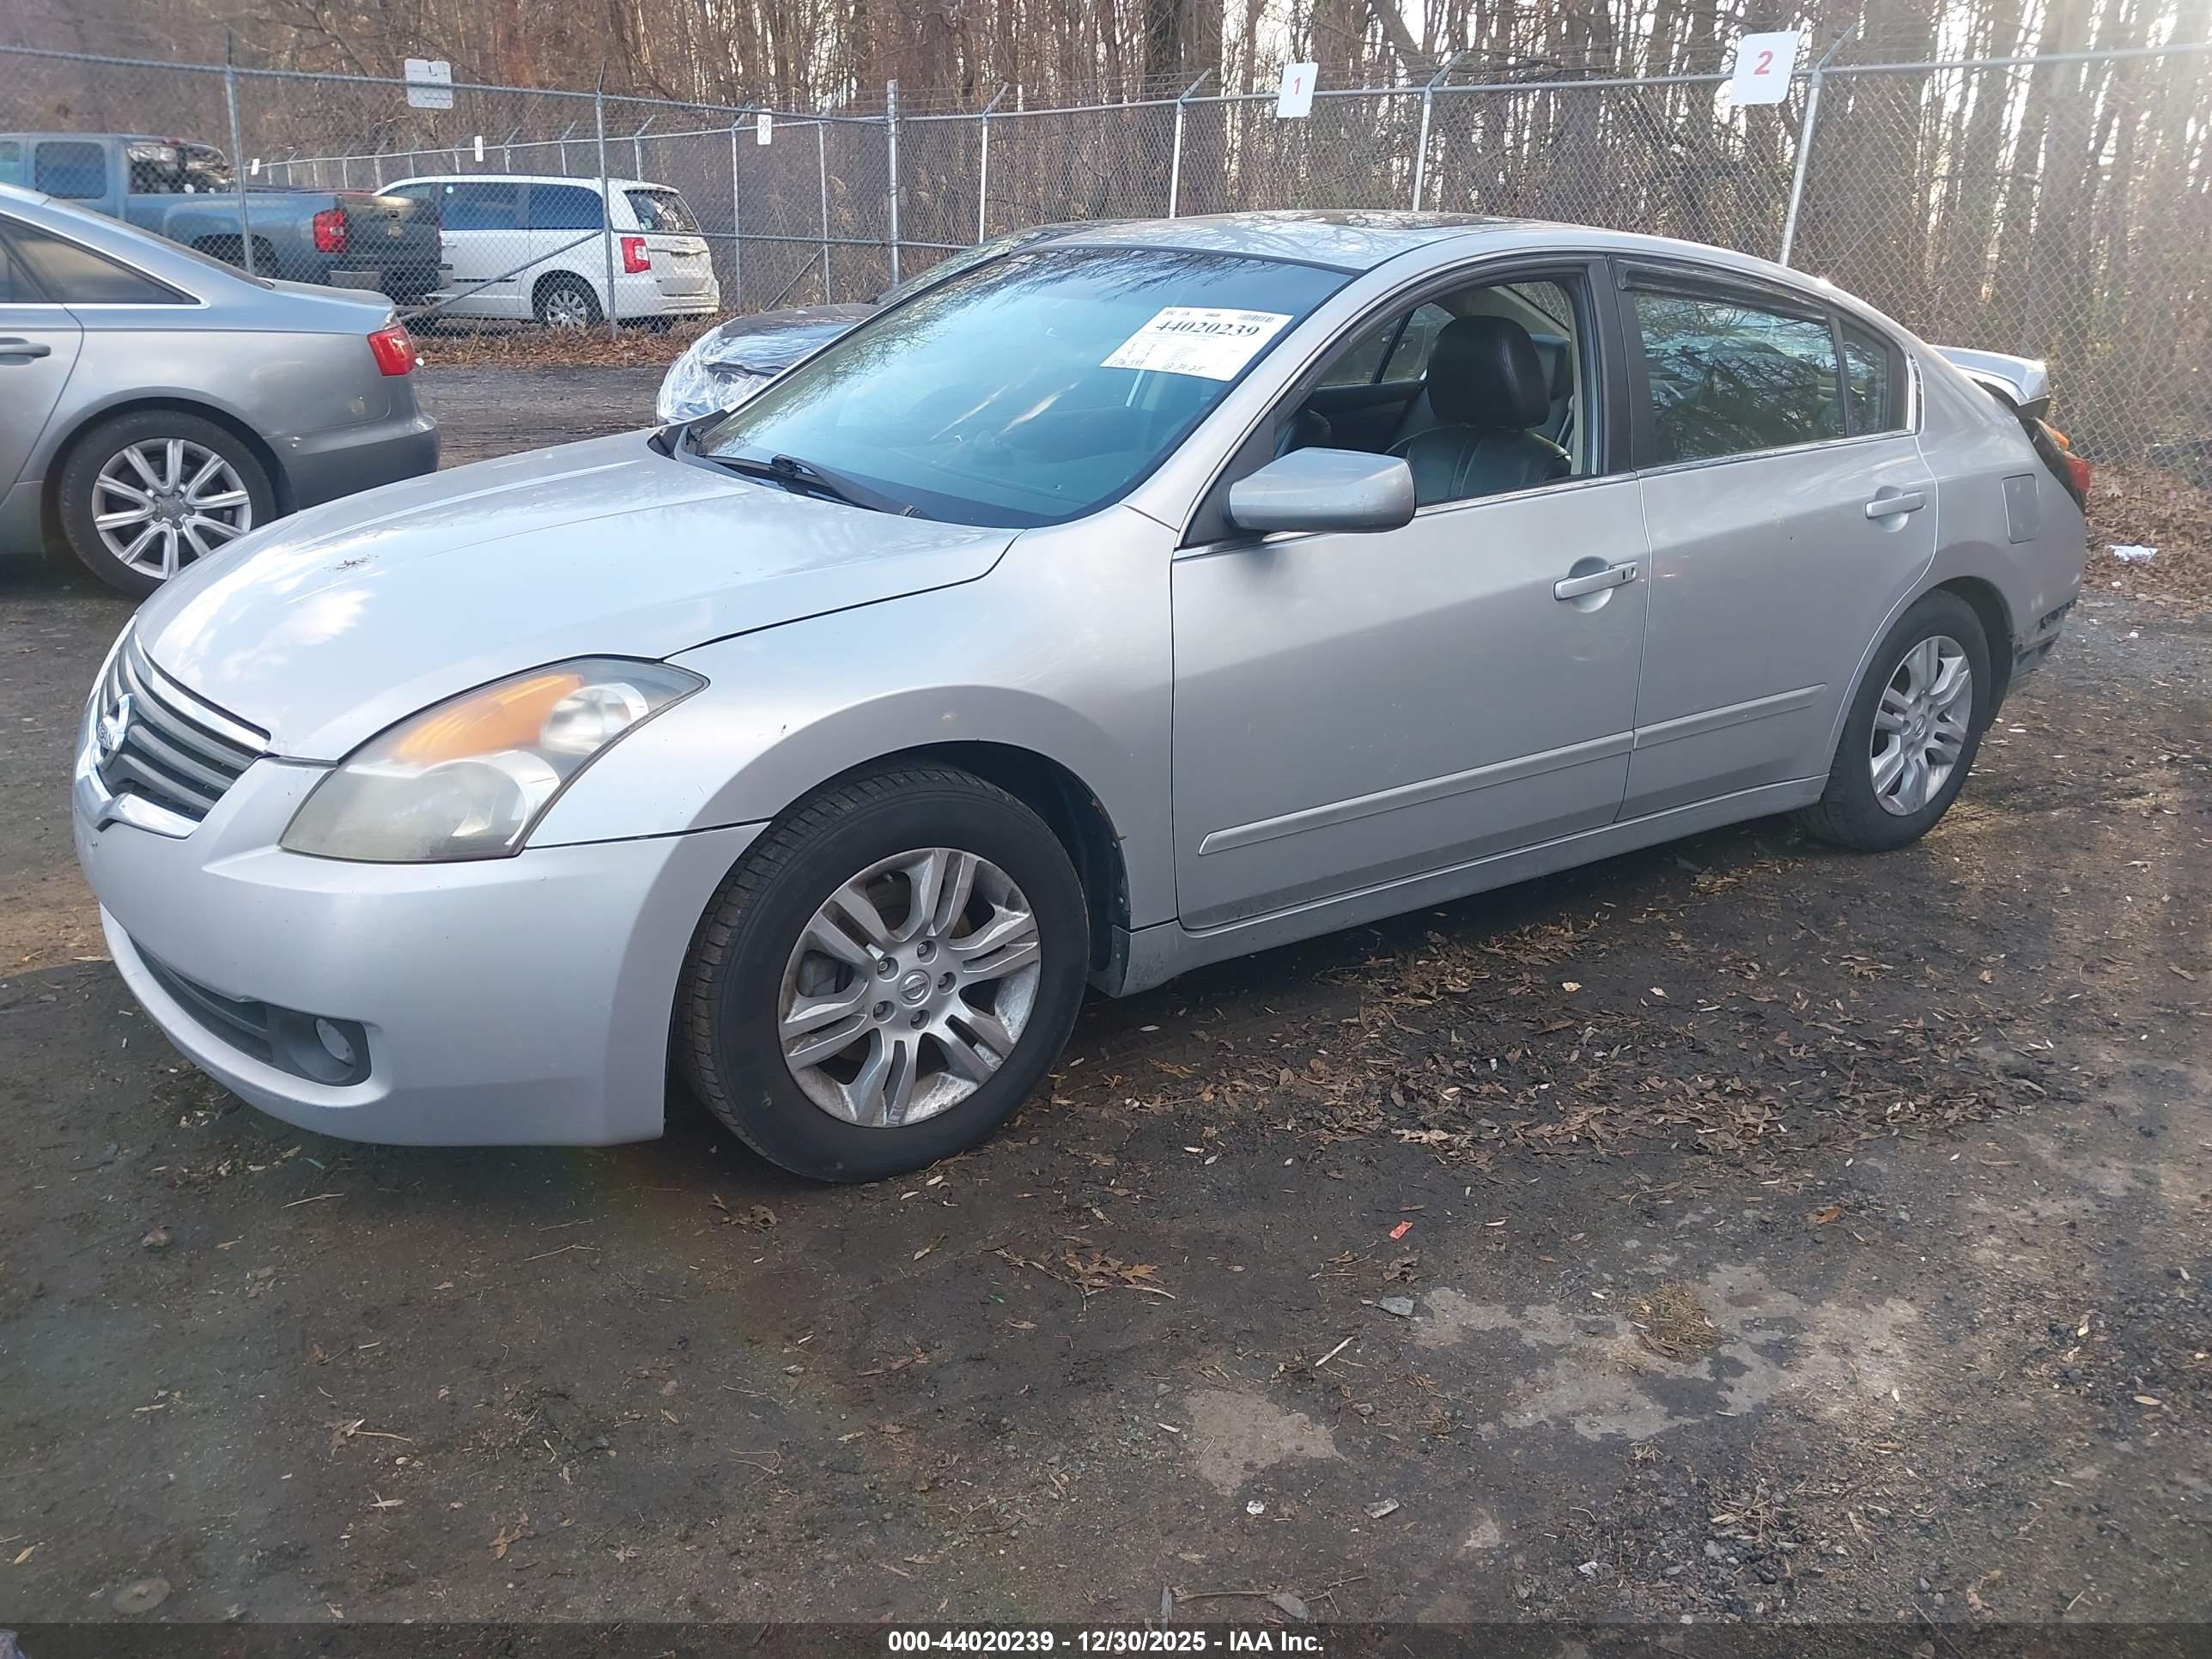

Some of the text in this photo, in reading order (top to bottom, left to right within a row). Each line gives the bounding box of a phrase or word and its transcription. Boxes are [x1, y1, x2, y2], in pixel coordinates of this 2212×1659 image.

[1753, 51, 1773, 75] 2
[1294, 77, 1301, 95] 1
[1156, 320, 1261, 337] 44020239
